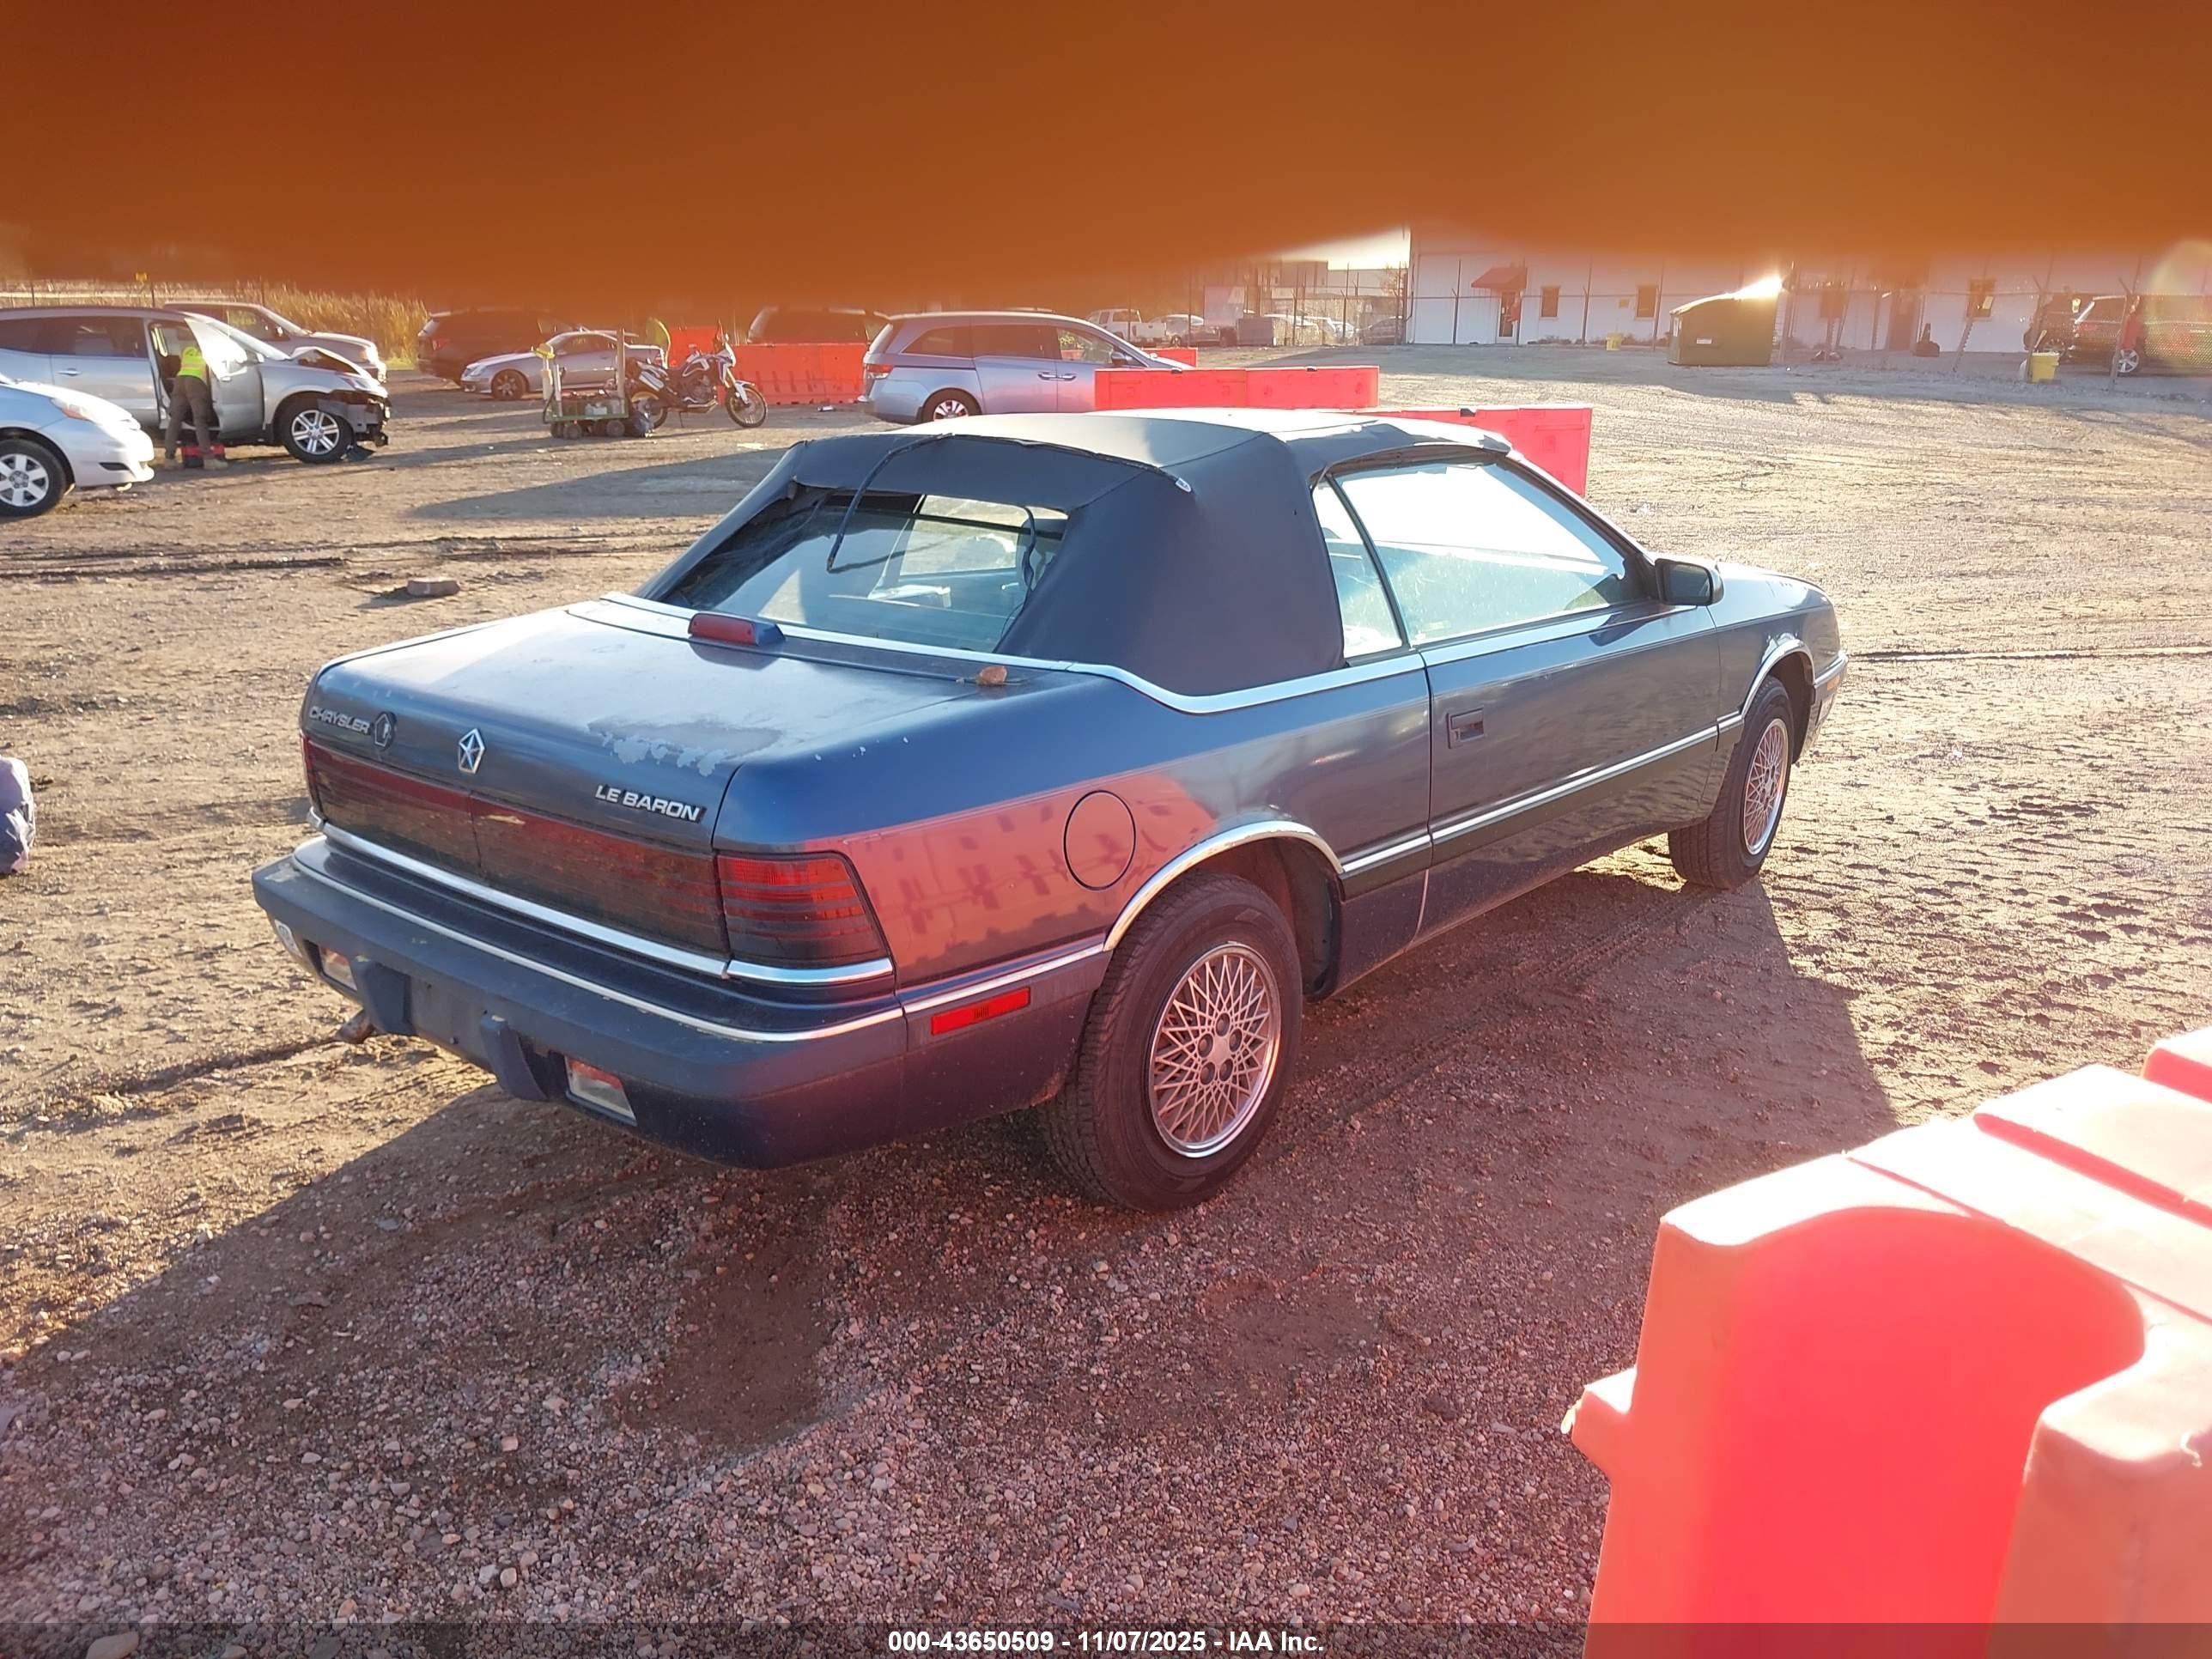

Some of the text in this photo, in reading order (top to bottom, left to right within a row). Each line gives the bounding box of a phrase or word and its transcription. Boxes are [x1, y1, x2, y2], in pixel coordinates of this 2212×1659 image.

[309, 706, 371, 734] CHRYSLER
[595, 785, 701, 821] LE BARON
